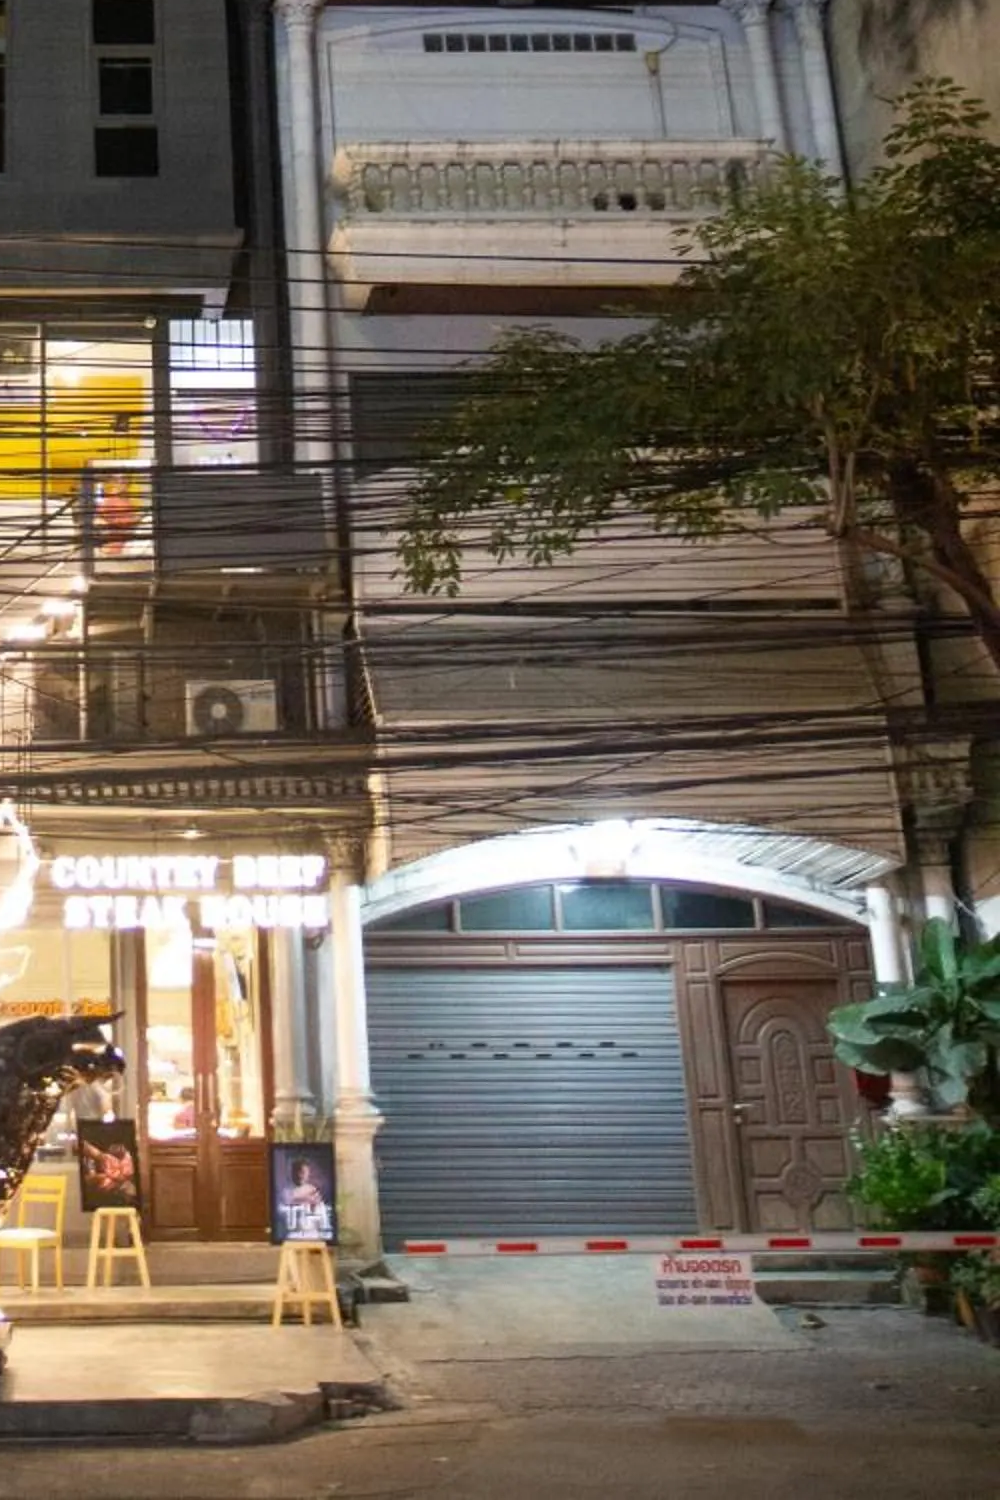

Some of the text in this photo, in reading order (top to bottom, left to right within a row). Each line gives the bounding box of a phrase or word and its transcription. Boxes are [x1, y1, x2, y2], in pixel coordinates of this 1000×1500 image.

[52, 855, 326, 888] COUNTRY BEEF
[64, 895, 190, 928] STEAK
